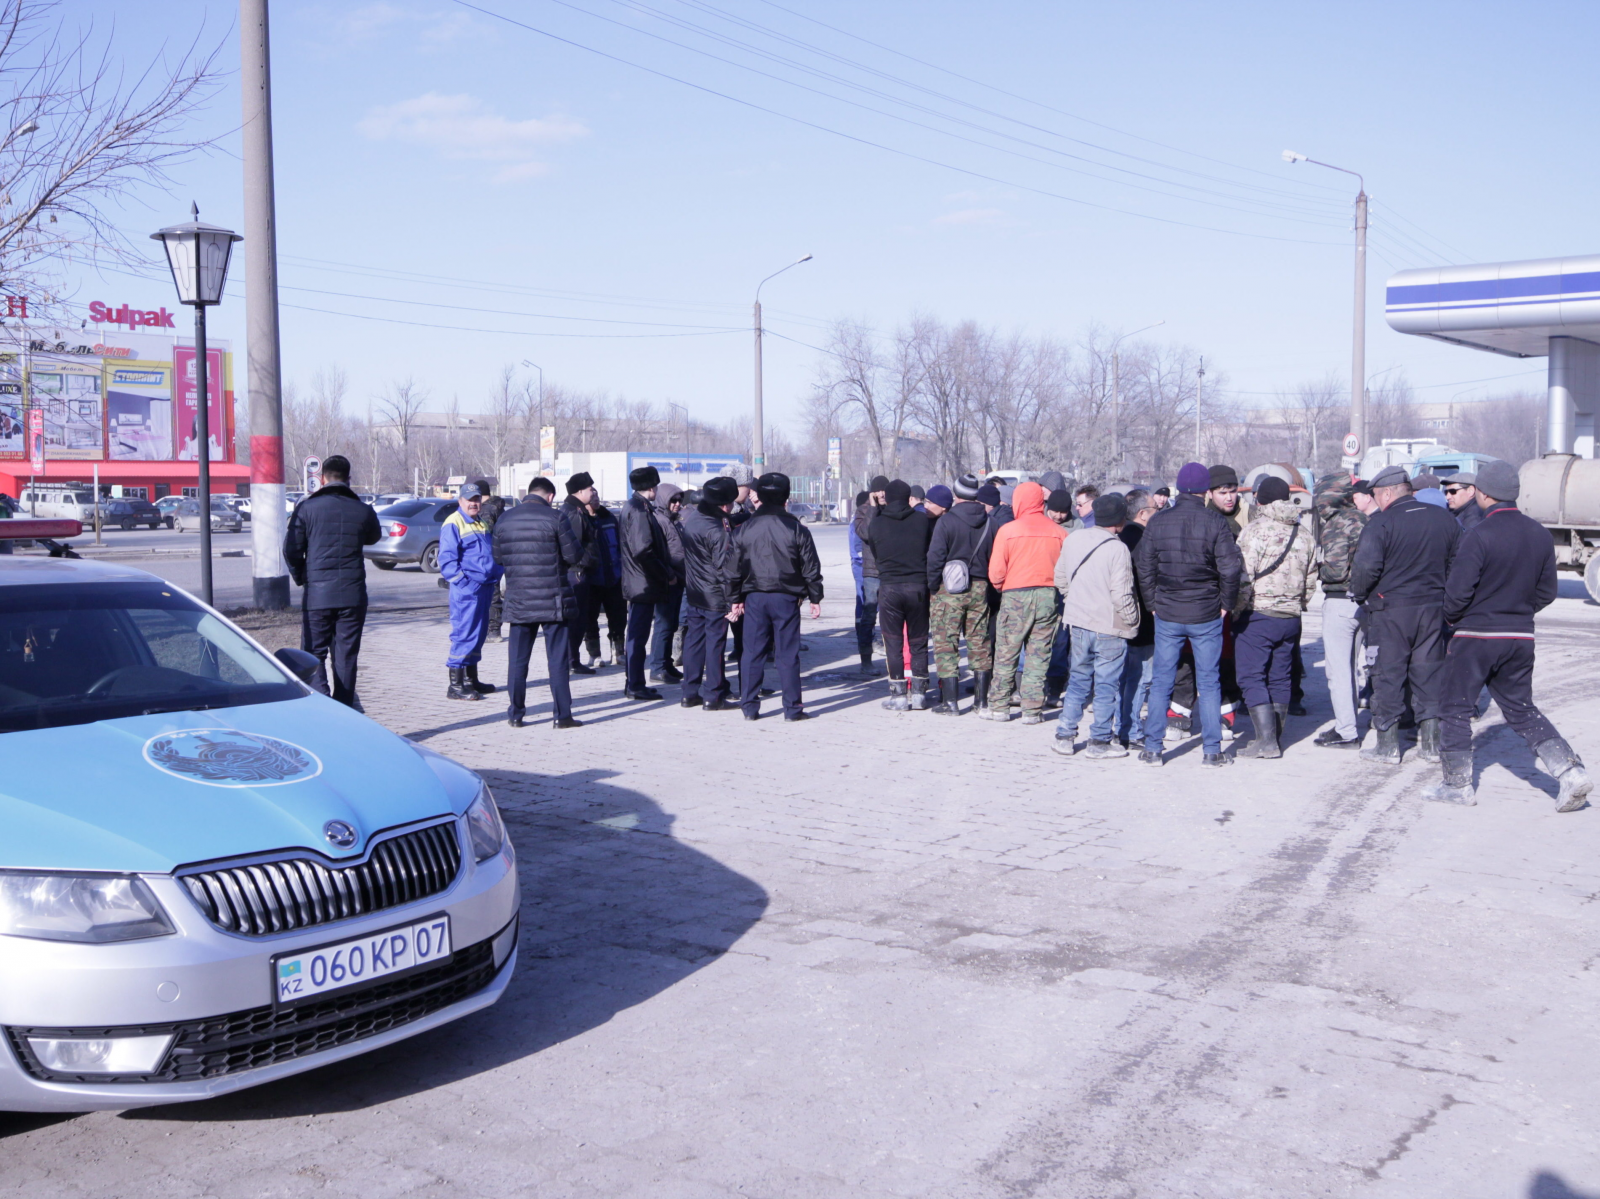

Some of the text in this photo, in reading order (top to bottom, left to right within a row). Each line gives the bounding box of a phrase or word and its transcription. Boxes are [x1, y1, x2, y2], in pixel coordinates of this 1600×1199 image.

[89, 300, 175, 330] Sulpak
[1346, 440, 1356, 449] 40
[310, 480, 316, 489] 5
[280, 978, 304, 996] KZ
